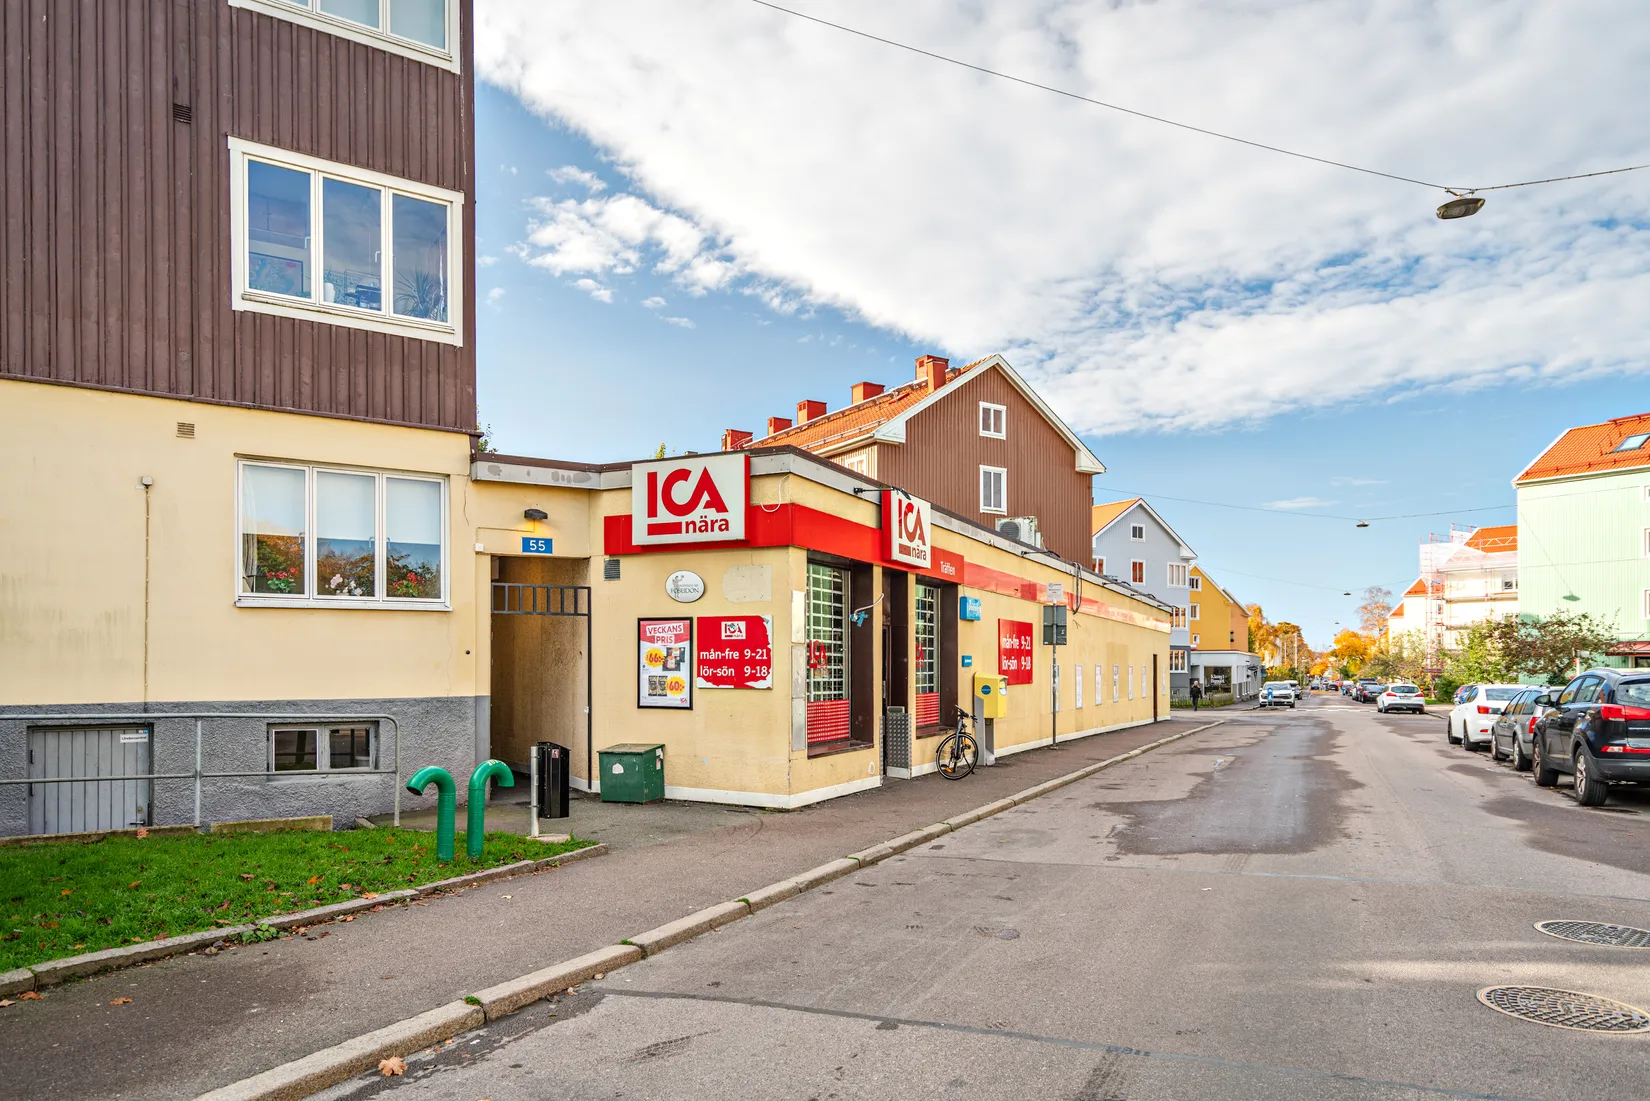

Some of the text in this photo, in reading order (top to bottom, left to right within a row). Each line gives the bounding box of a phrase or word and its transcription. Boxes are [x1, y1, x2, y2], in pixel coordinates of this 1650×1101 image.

[647, 466, 729, 518] ICA
[685, 515, 730, 534] nära
[898, 498, 927, 546] ICA
[529, 540, 546, 551] 55
[911, 545, 927, 561] nära
[647, 624, 683, 635] VECKANS
[655, 636, 674, 644] PRIS
[1020, 635, 1031, 650] 9-21
[700, 648, 768, 660] mån-fre 9-21
[1020, 655, 1031, 671] 9-18
[700, 665, 769, 677] lör-sön 9-18
